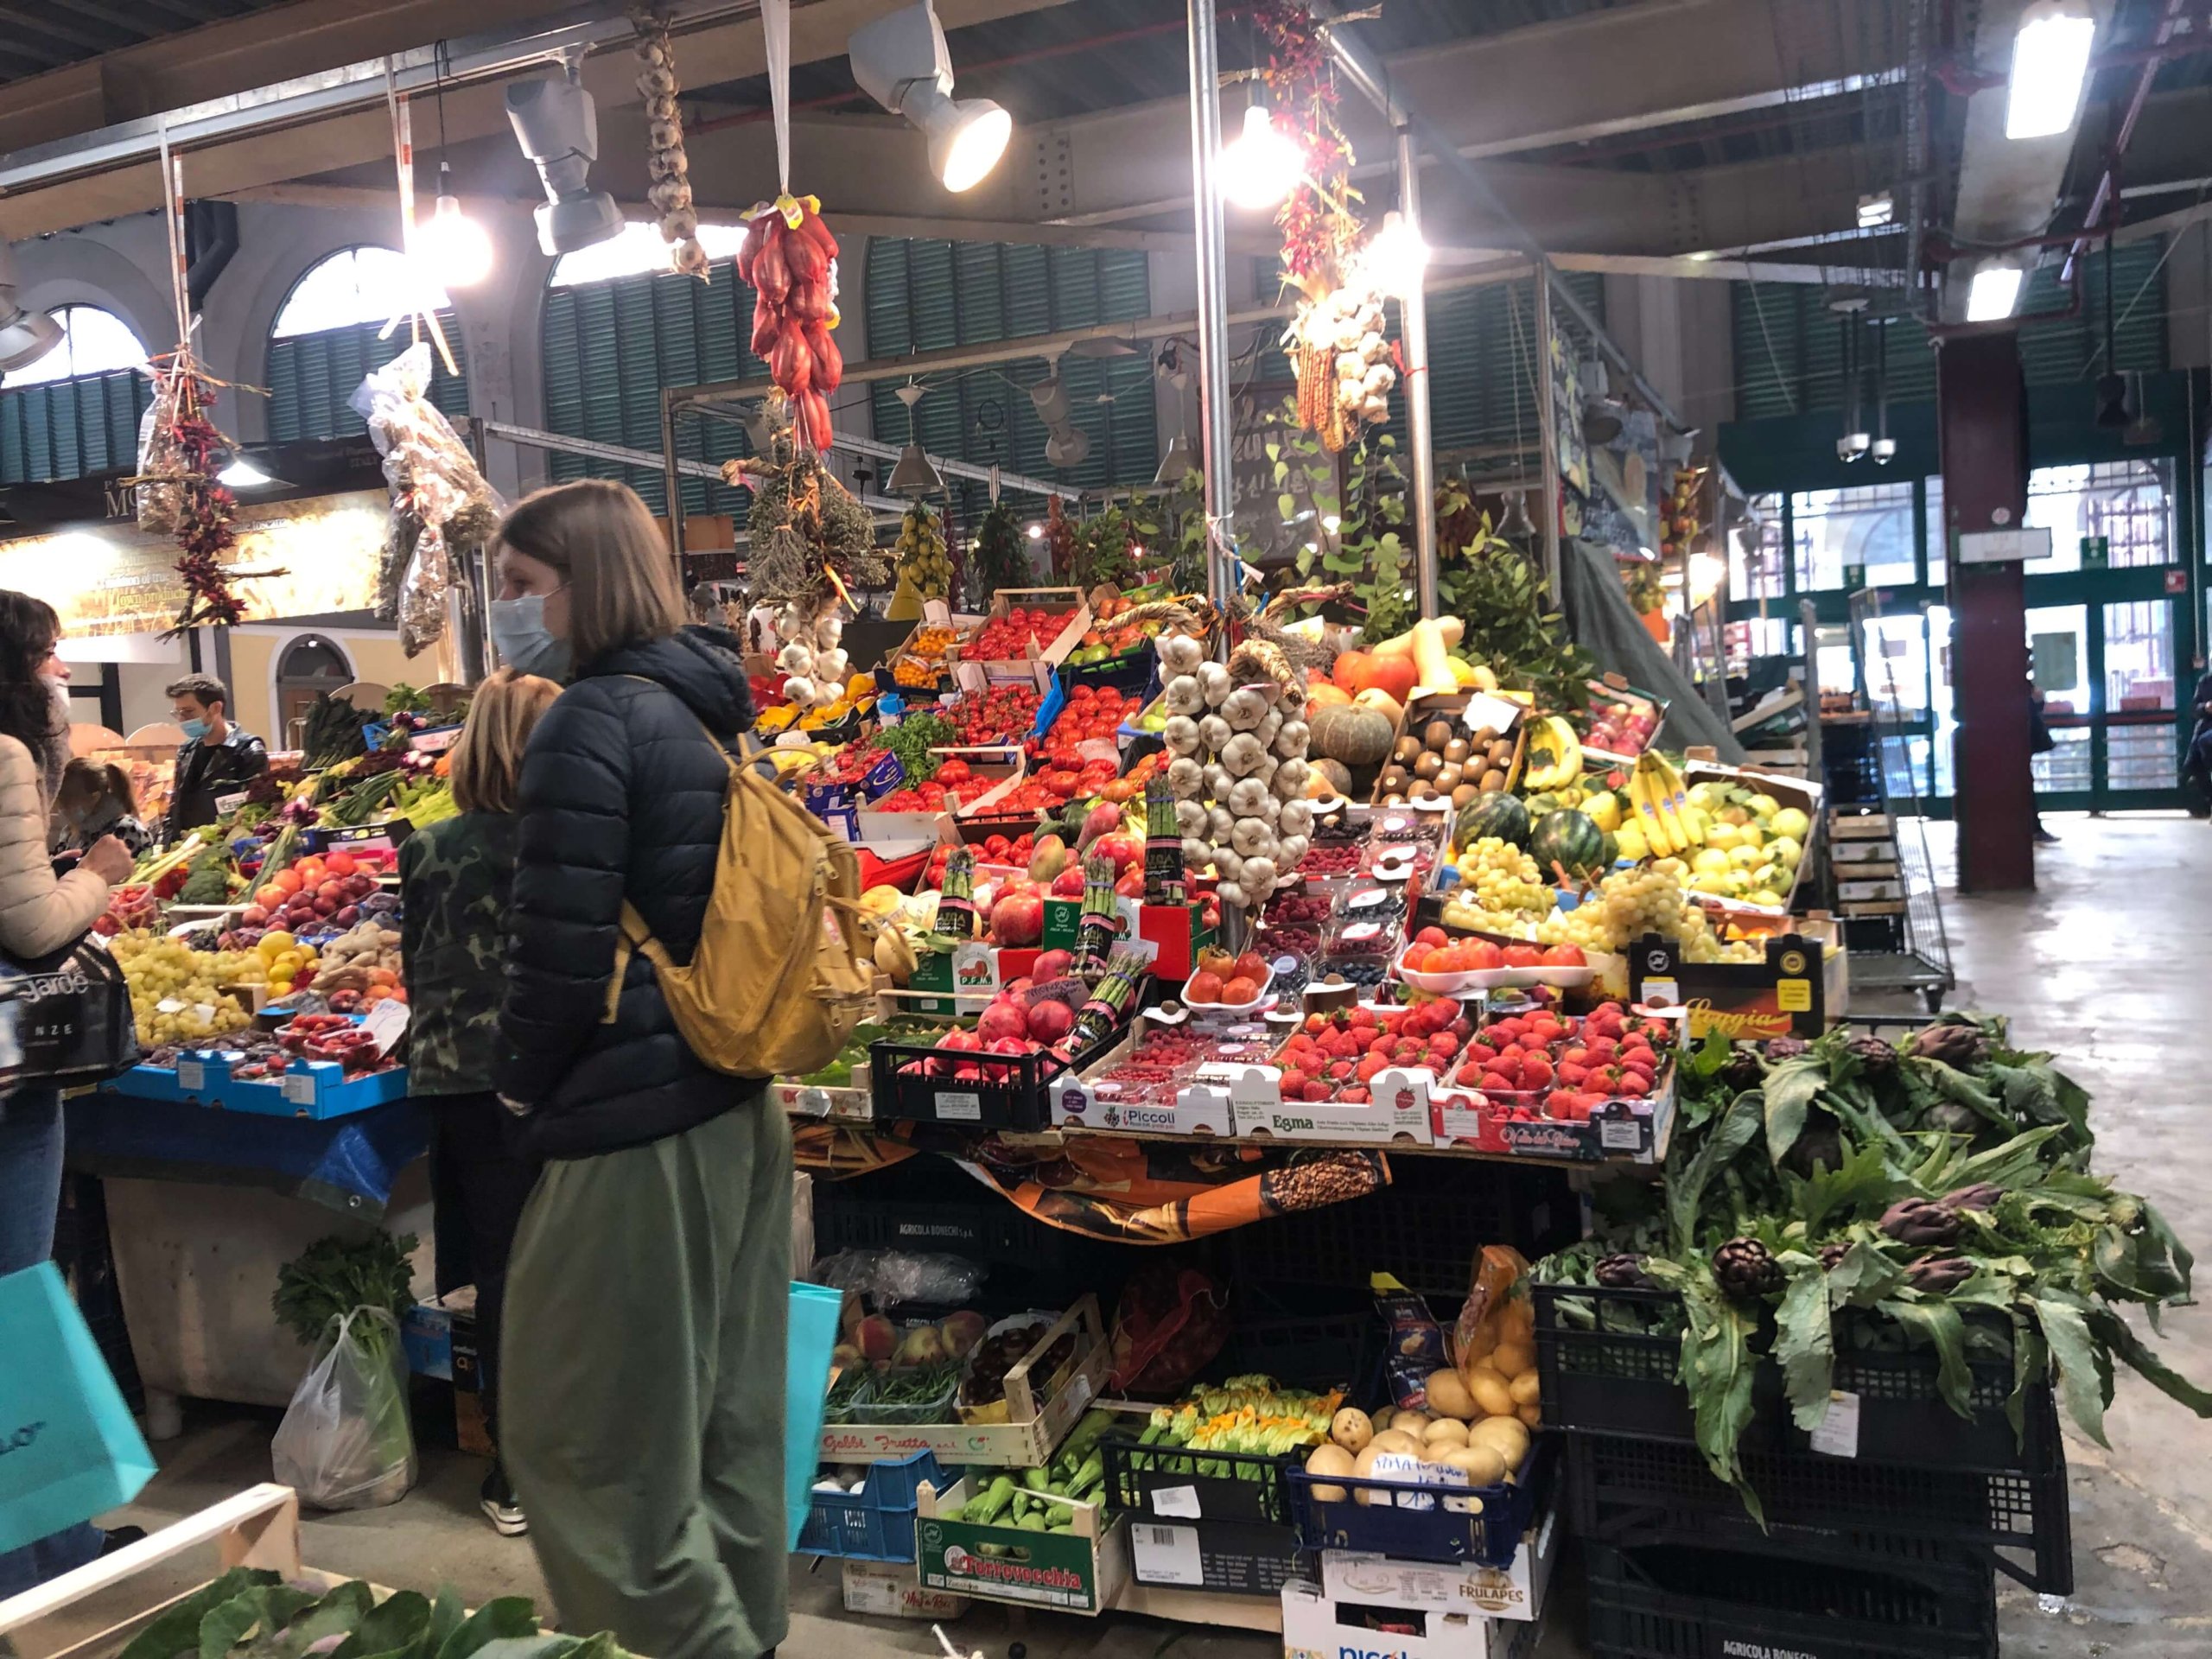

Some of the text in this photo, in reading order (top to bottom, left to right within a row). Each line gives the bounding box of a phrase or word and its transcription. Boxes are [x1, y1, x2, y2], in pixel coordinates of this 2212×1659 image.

[1272, 1115, 1314, 1132] Egma
[899, 1224, 930, 1236] AGRICOLA
[931, 1224, 958, 1236] BONECHI
[874, 1435, 931, 1451] Frutta
[1459, 1584, 1523, 1604] FRULAPES
[1723, 1639, 1770, 1659] AGRICOLA
